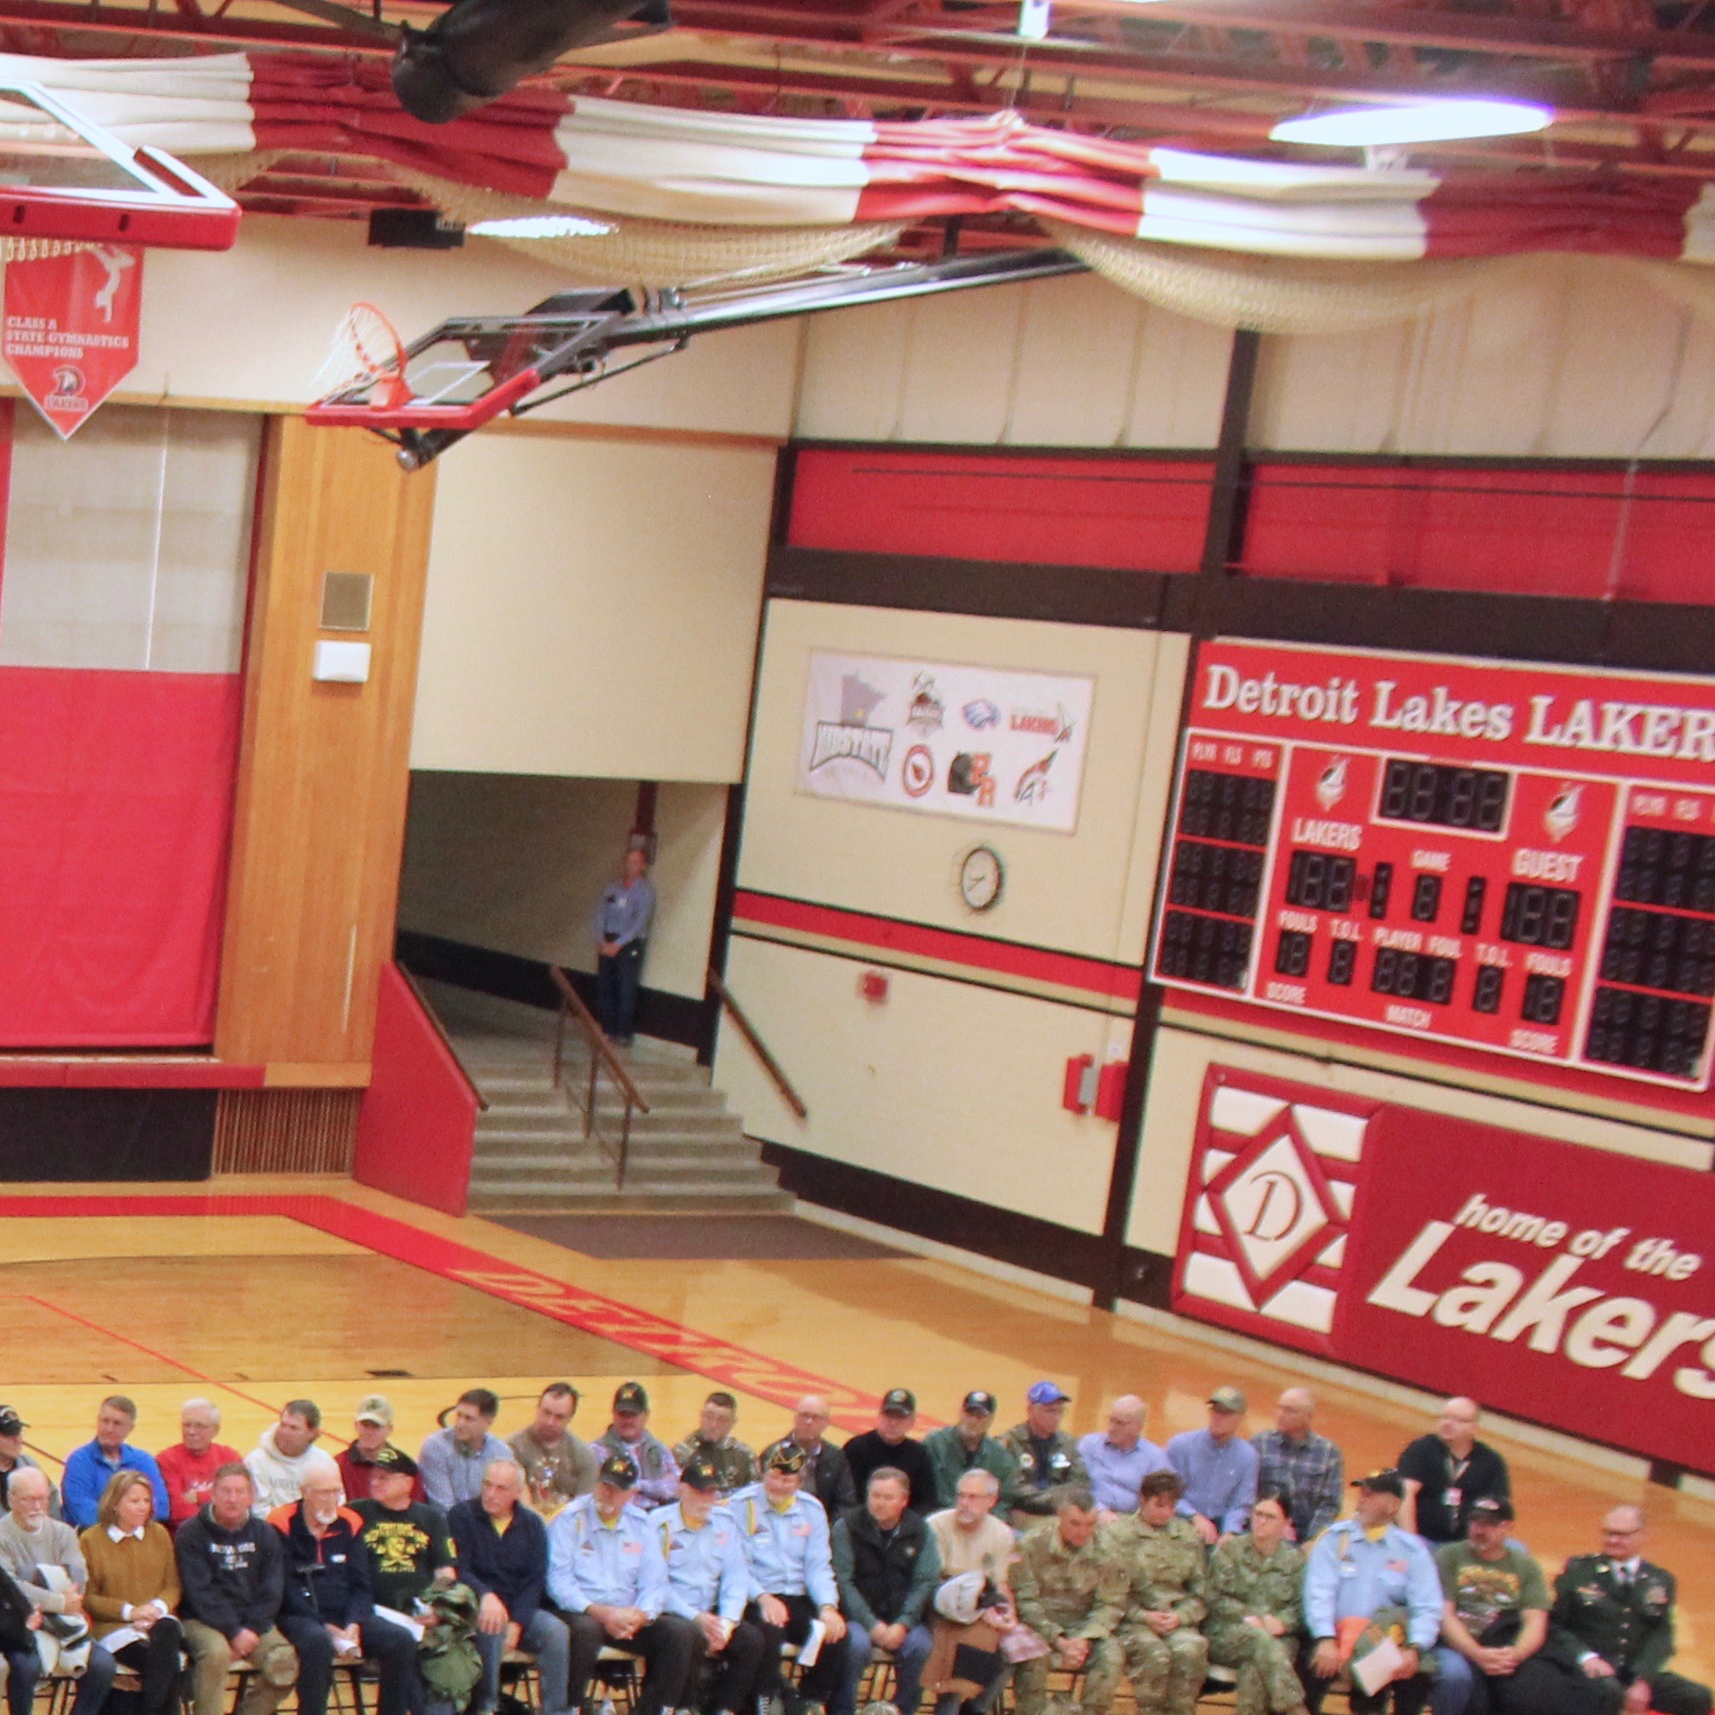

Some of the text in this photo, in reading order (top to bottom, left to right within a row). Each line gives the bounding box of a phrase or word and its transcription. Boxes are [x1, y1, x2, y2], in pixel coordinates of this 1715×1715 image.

[7, 316, 46, 329] CLASS
[7, 330, 129, 348] STATE GYMNASTICS
[6, 343, 84, 359] CHAMPIONS
[1203, 663, 1360, 725] Detroit
[1369, 680, 1515, 742] Lakes
[1291, 817, 1362, 851] LAKERS
[1511, 848, 1585, 883] GUEST
[1373, 926, 1422, 951] PLAYER
[1242, 1171, 1304, 1241] D
[1455, 1194, 1702, 1281] home of the
